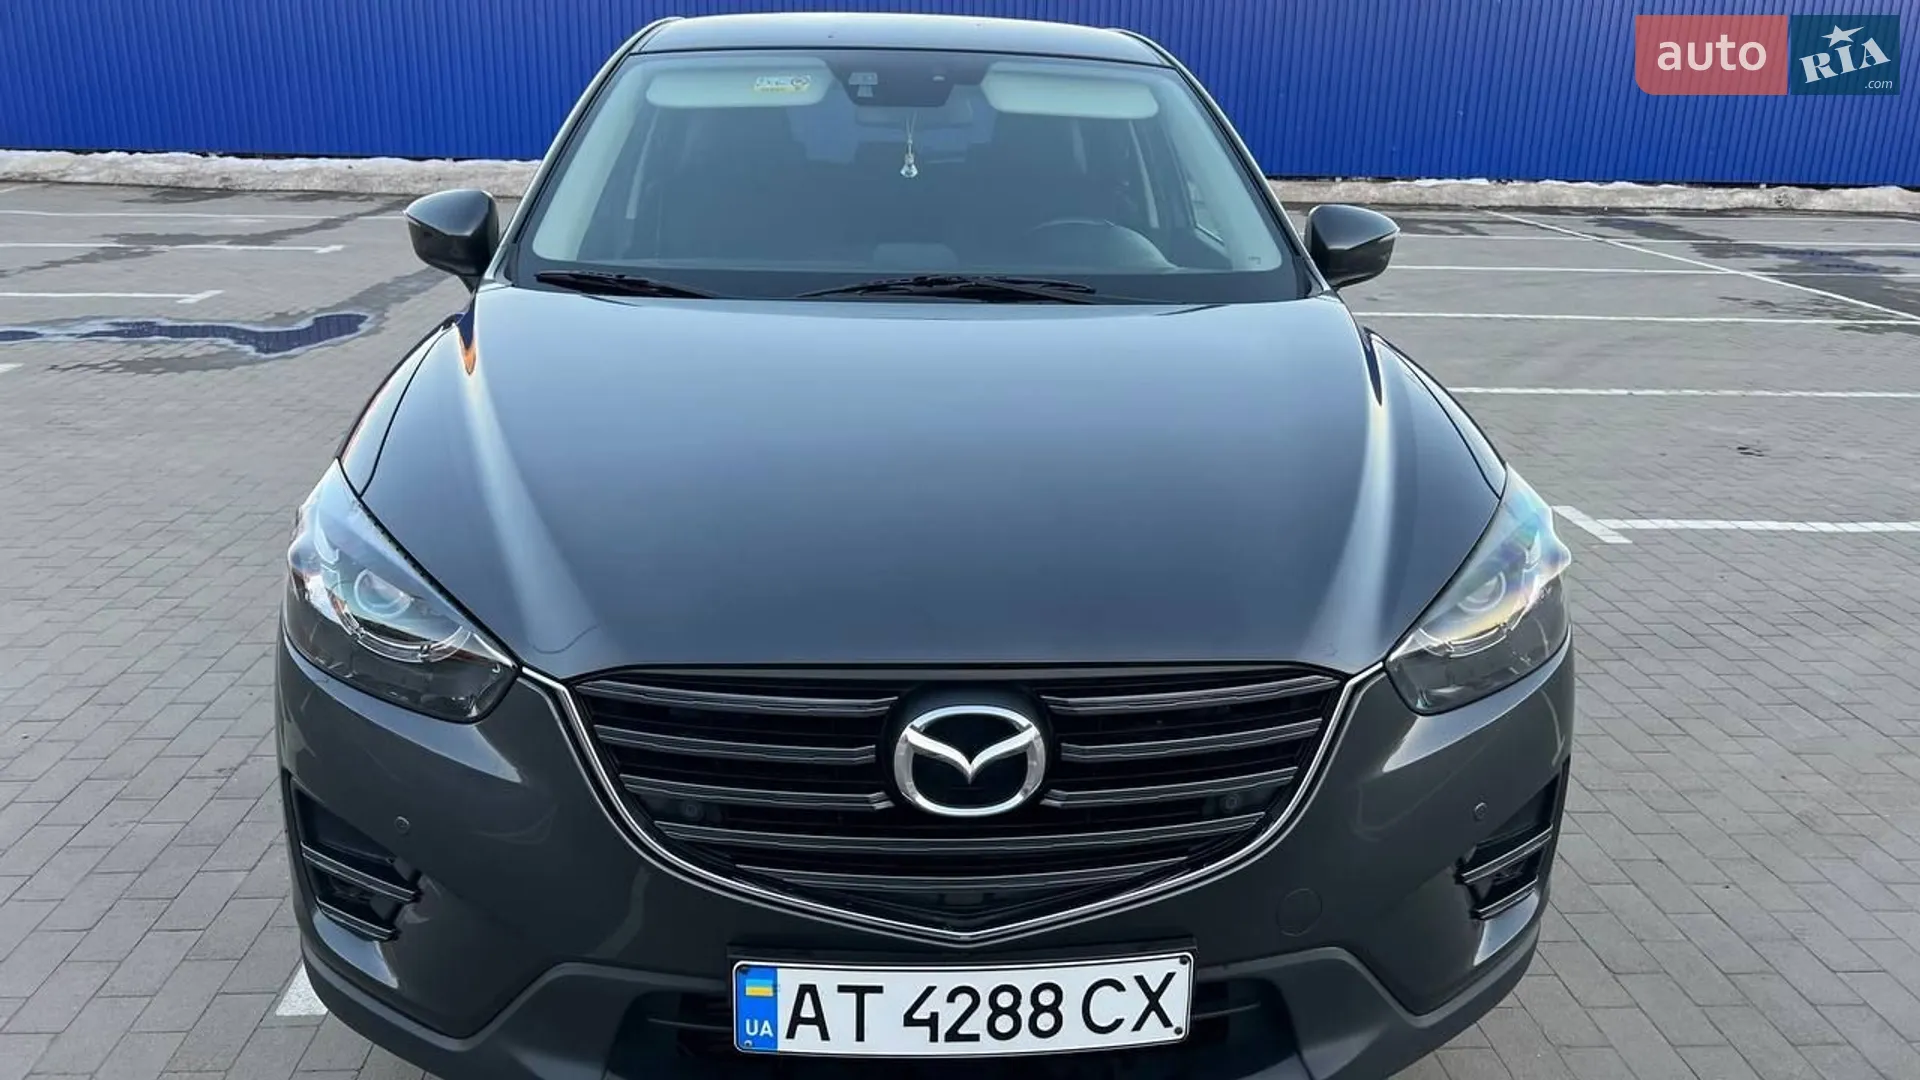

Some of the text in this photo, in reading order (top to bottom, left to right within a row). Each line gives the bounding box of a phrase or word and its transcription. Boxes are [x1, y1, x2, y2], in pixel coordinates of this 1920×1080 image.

[745, 1019, 774, 1038] UA
[785, 971, 1177, 1043] AT 4288 CX
